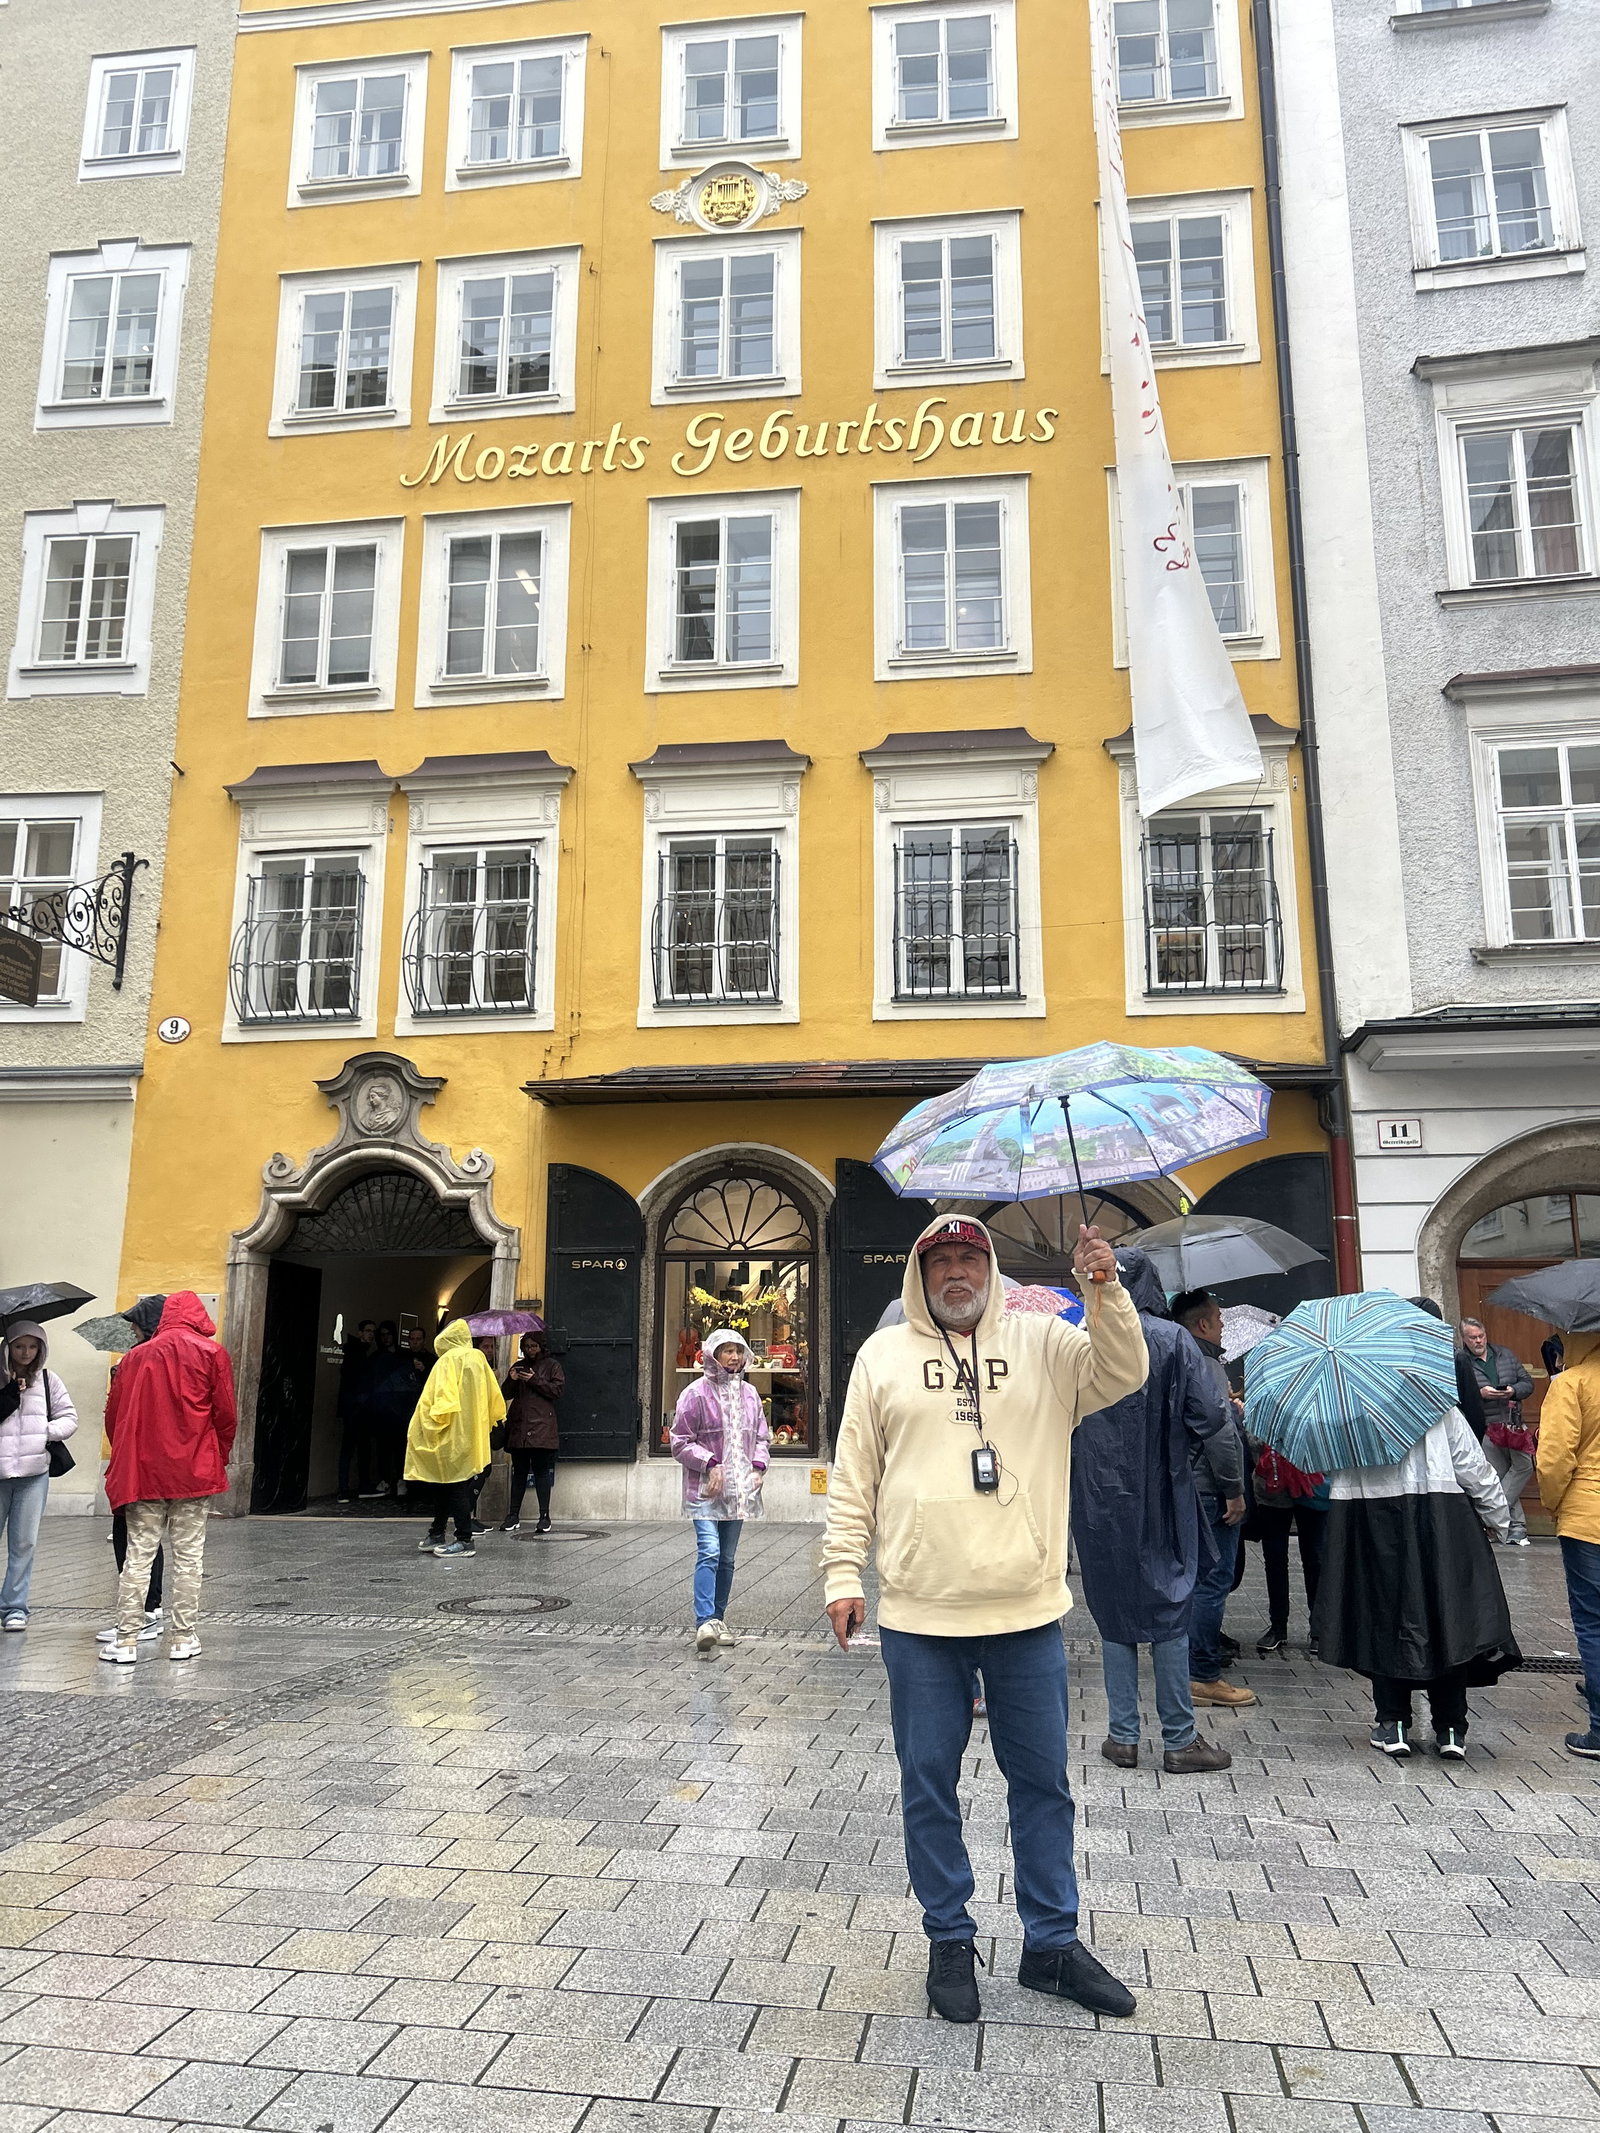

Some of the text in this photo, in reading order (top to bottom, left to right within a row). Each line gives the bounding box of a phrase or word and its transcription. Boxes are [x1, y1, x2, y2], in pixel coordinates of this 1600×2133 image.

[400, 397, 1059, 487] Mozarts Geburtshaus
[170, 1019, 179, 1035] 9
[1388, 1123, 1411, 1138] 11
[941, 1220, 976, 1235] XICO
[571, 1260, 614, 1269] SPAR
[863, 1254, 907, 1264] SPAR
[923, 1358, 1009, 1391] GAP
[955, 1411, 980, 1422] 1969
